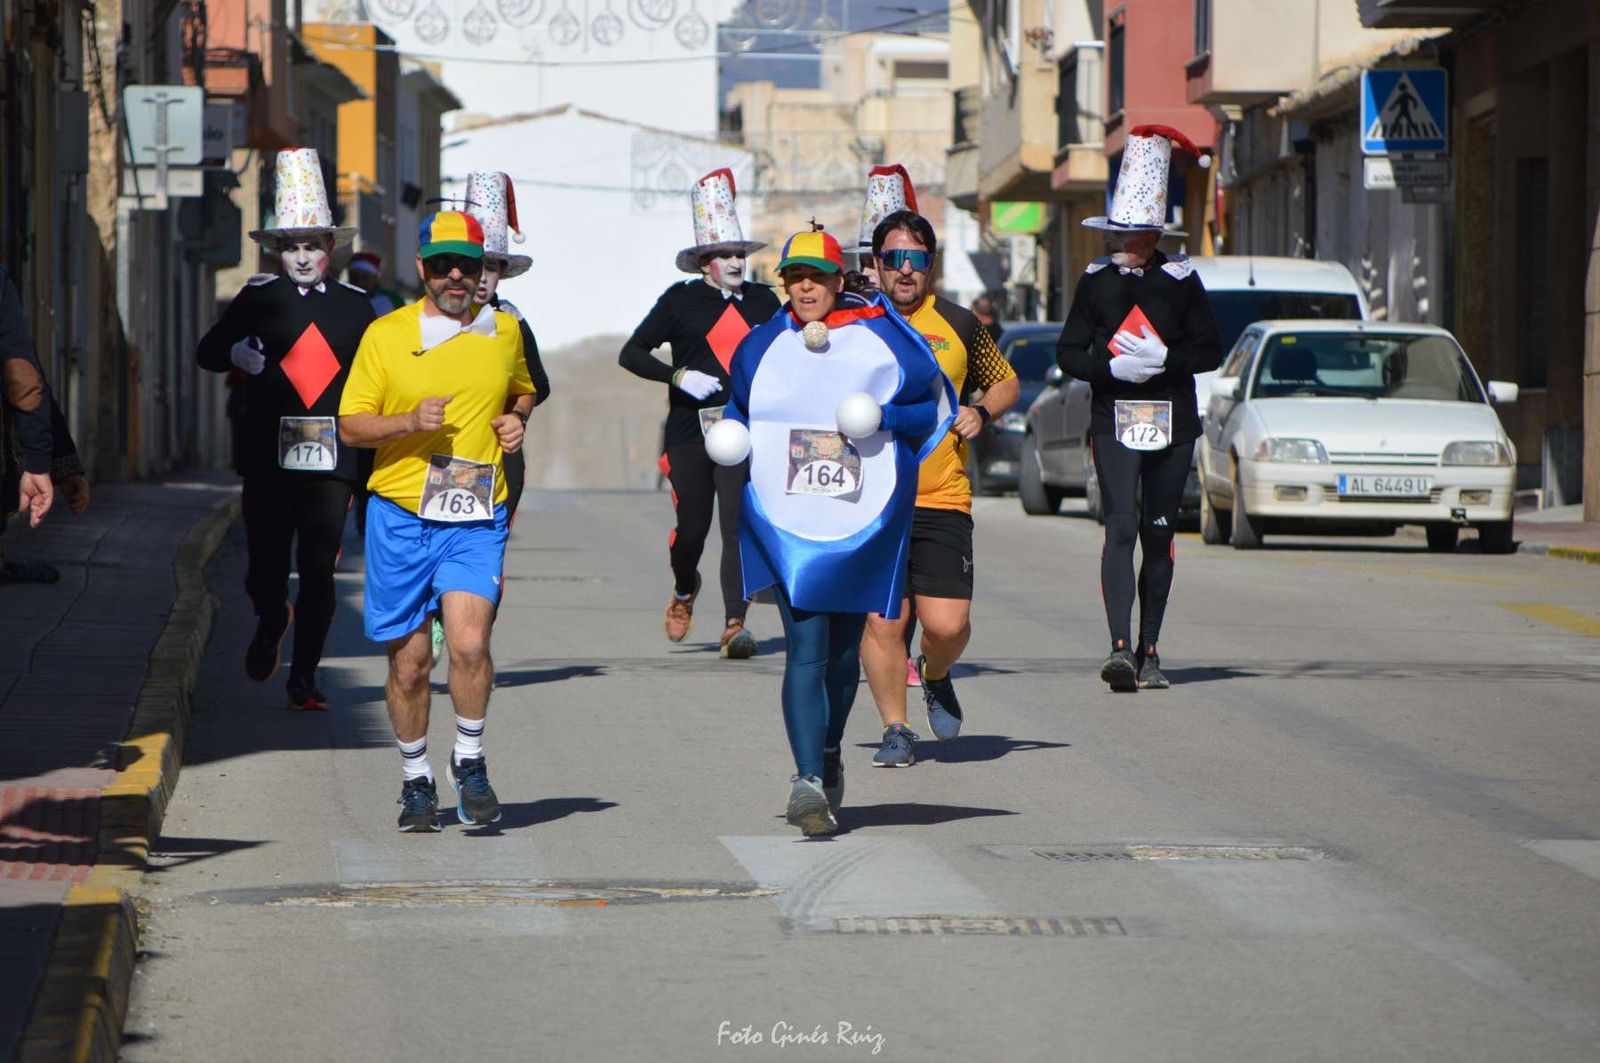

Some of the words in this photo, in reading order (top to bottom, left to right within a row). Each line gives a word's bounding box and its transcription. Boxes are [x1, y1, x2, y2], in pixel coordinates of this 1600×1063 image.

[1128, 426, 1159, 442] 172
[292, 445, 323, 462] 171
[804, 464, 846, 488] 164
[1351, 477, 1369, 493] AL
[1374, 478, 1414, 493] 6449
[438, 491, 476, 515] 163
